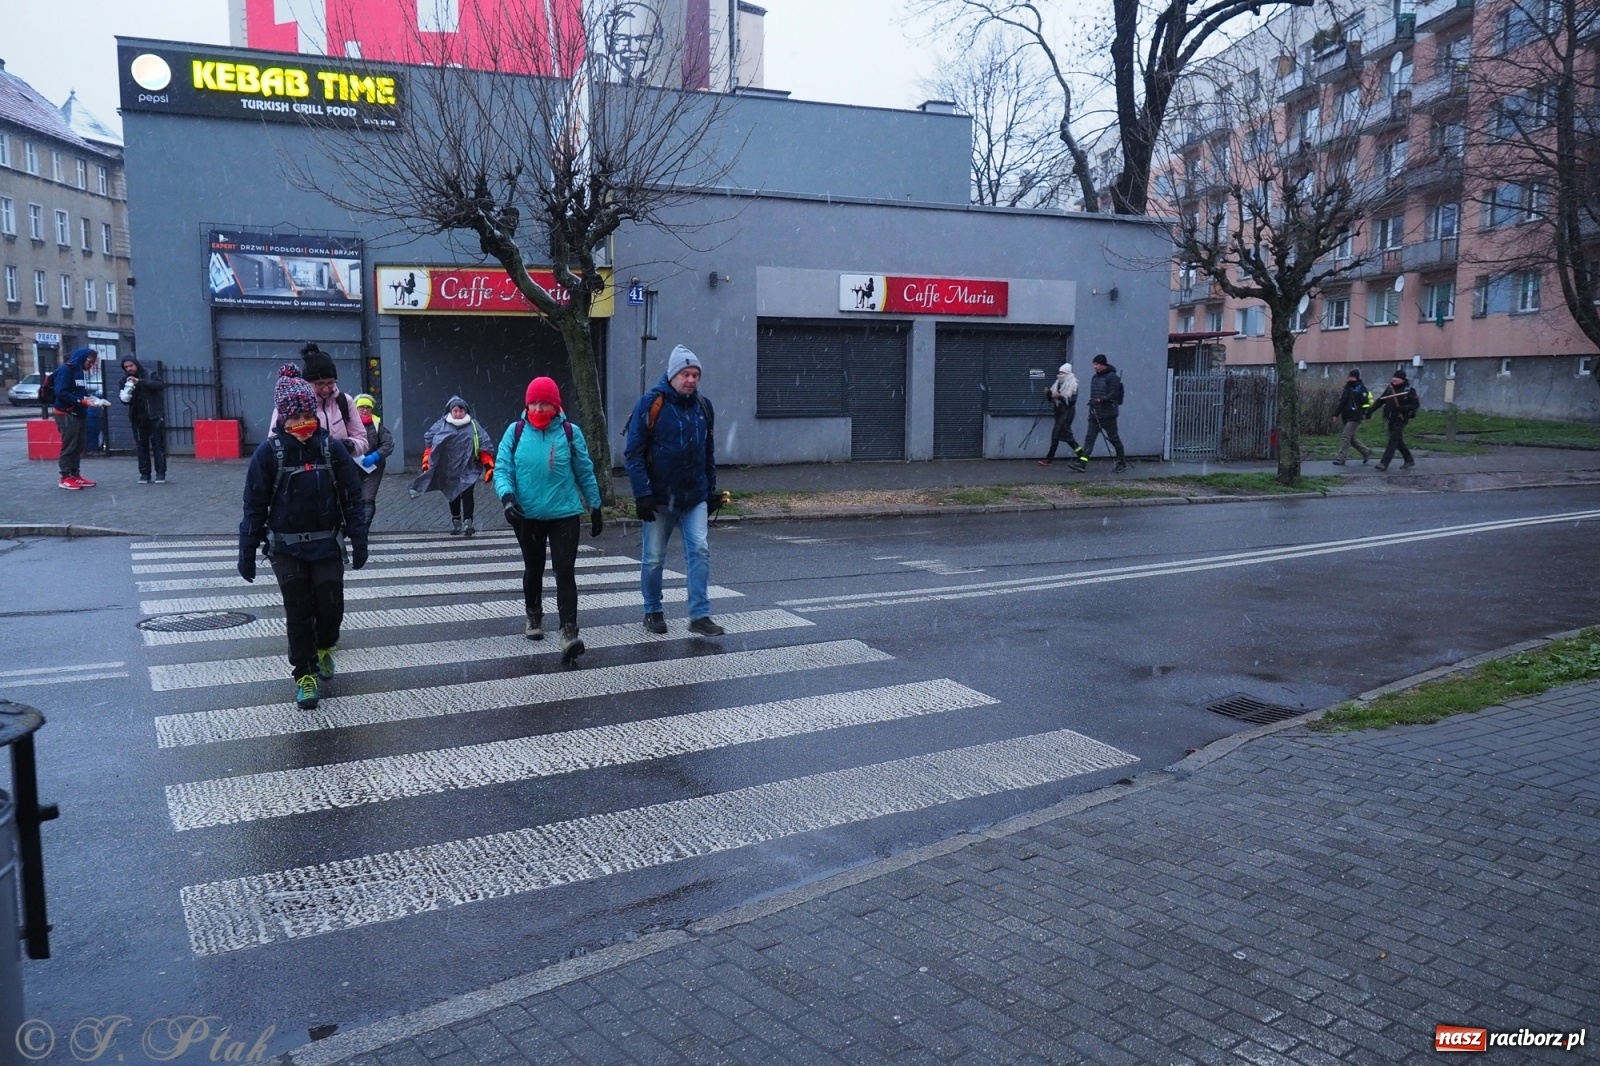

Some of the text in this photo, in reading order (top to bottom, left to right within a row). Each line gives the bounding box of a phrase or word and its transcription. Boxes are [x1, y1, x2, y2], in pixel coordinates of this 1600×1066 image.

[192, 60, 396, 105] KEBAB TIME
[138, 93, 169, 104] pepsi
[240, 98, 357, 118] TURKISH GRILL FOOD
[211, 242, 237, 250] EXPERT
[240, 243, 266, 252] DRZWI
[269, 246, 304, 254] PODŁOGI
[440, 276, 493, 307] Caffe
[629, 286, 644, 300] 41
[903, 283, 995, 308] Caffe Maria
